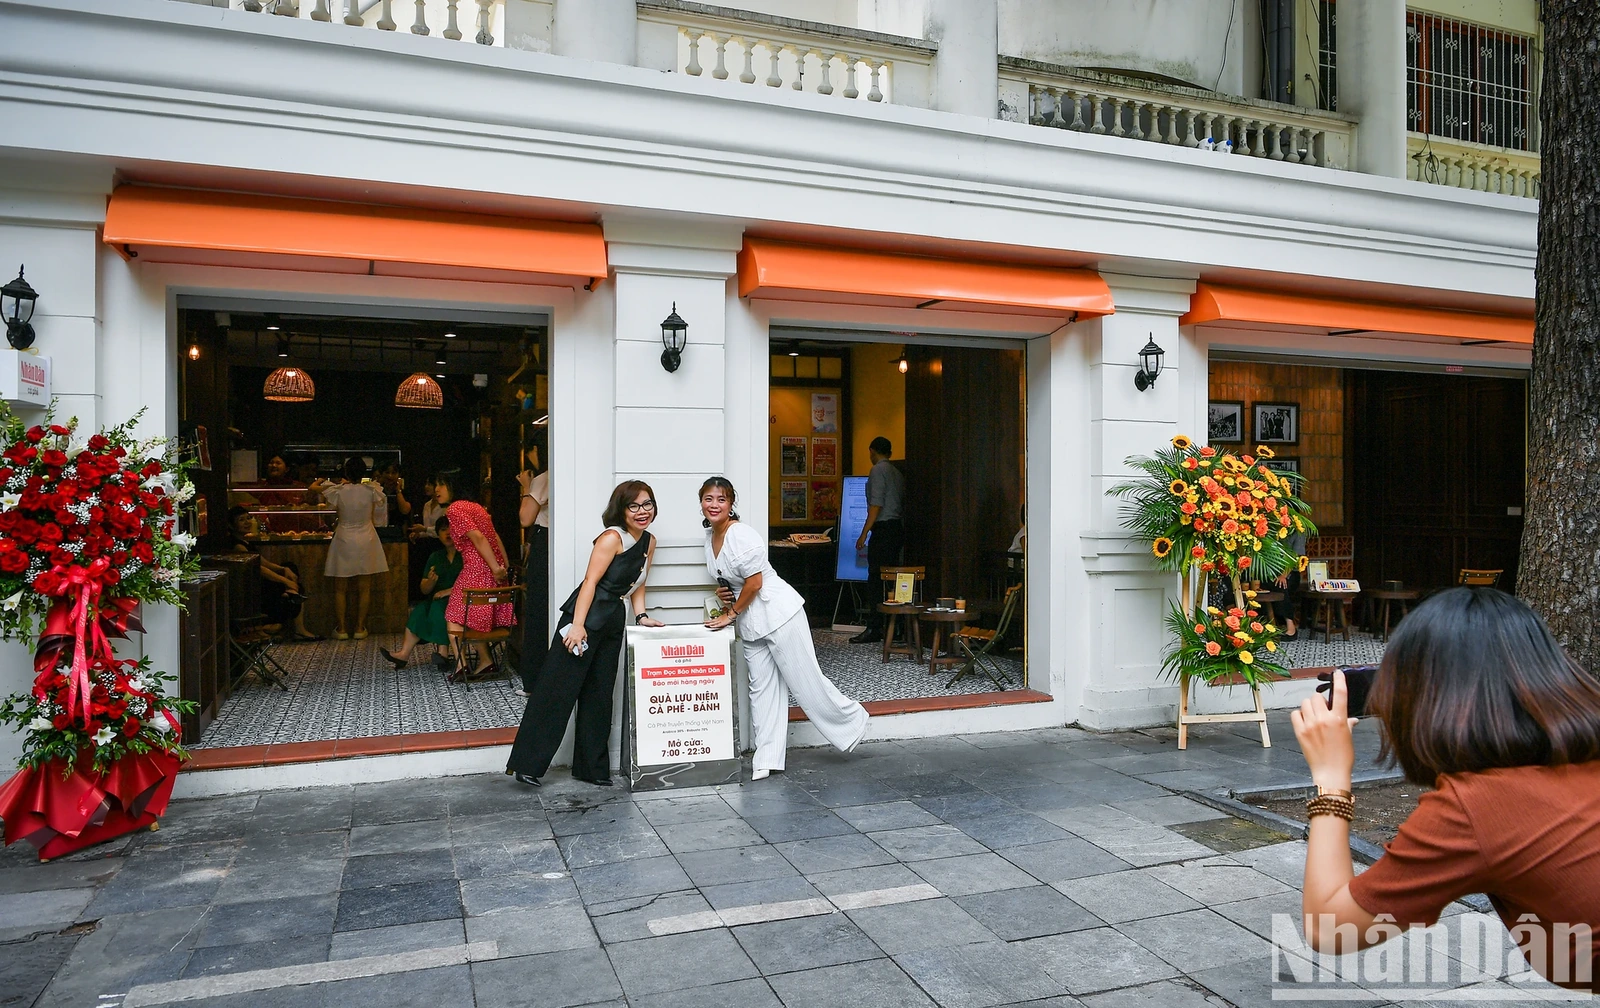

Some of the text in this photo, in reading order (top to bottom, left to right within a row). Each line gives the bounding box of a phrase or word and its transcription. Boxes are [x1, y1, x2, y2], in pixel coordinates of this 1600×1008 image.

[661, 644, 704, 656] Nhân Dân
[650, 691, 718, 704] QUÀ LƯU NIỆM
[649, 704, 664, 714] CÀ
[667, 703, 685, 713] PHÊ
[693, 702, 720, 712] BÁNH
[668, 738, 704, 747] Mở cửa:
[662, 748, 680, 757] 7:00
[687, 747, 710, 755] 22:30
